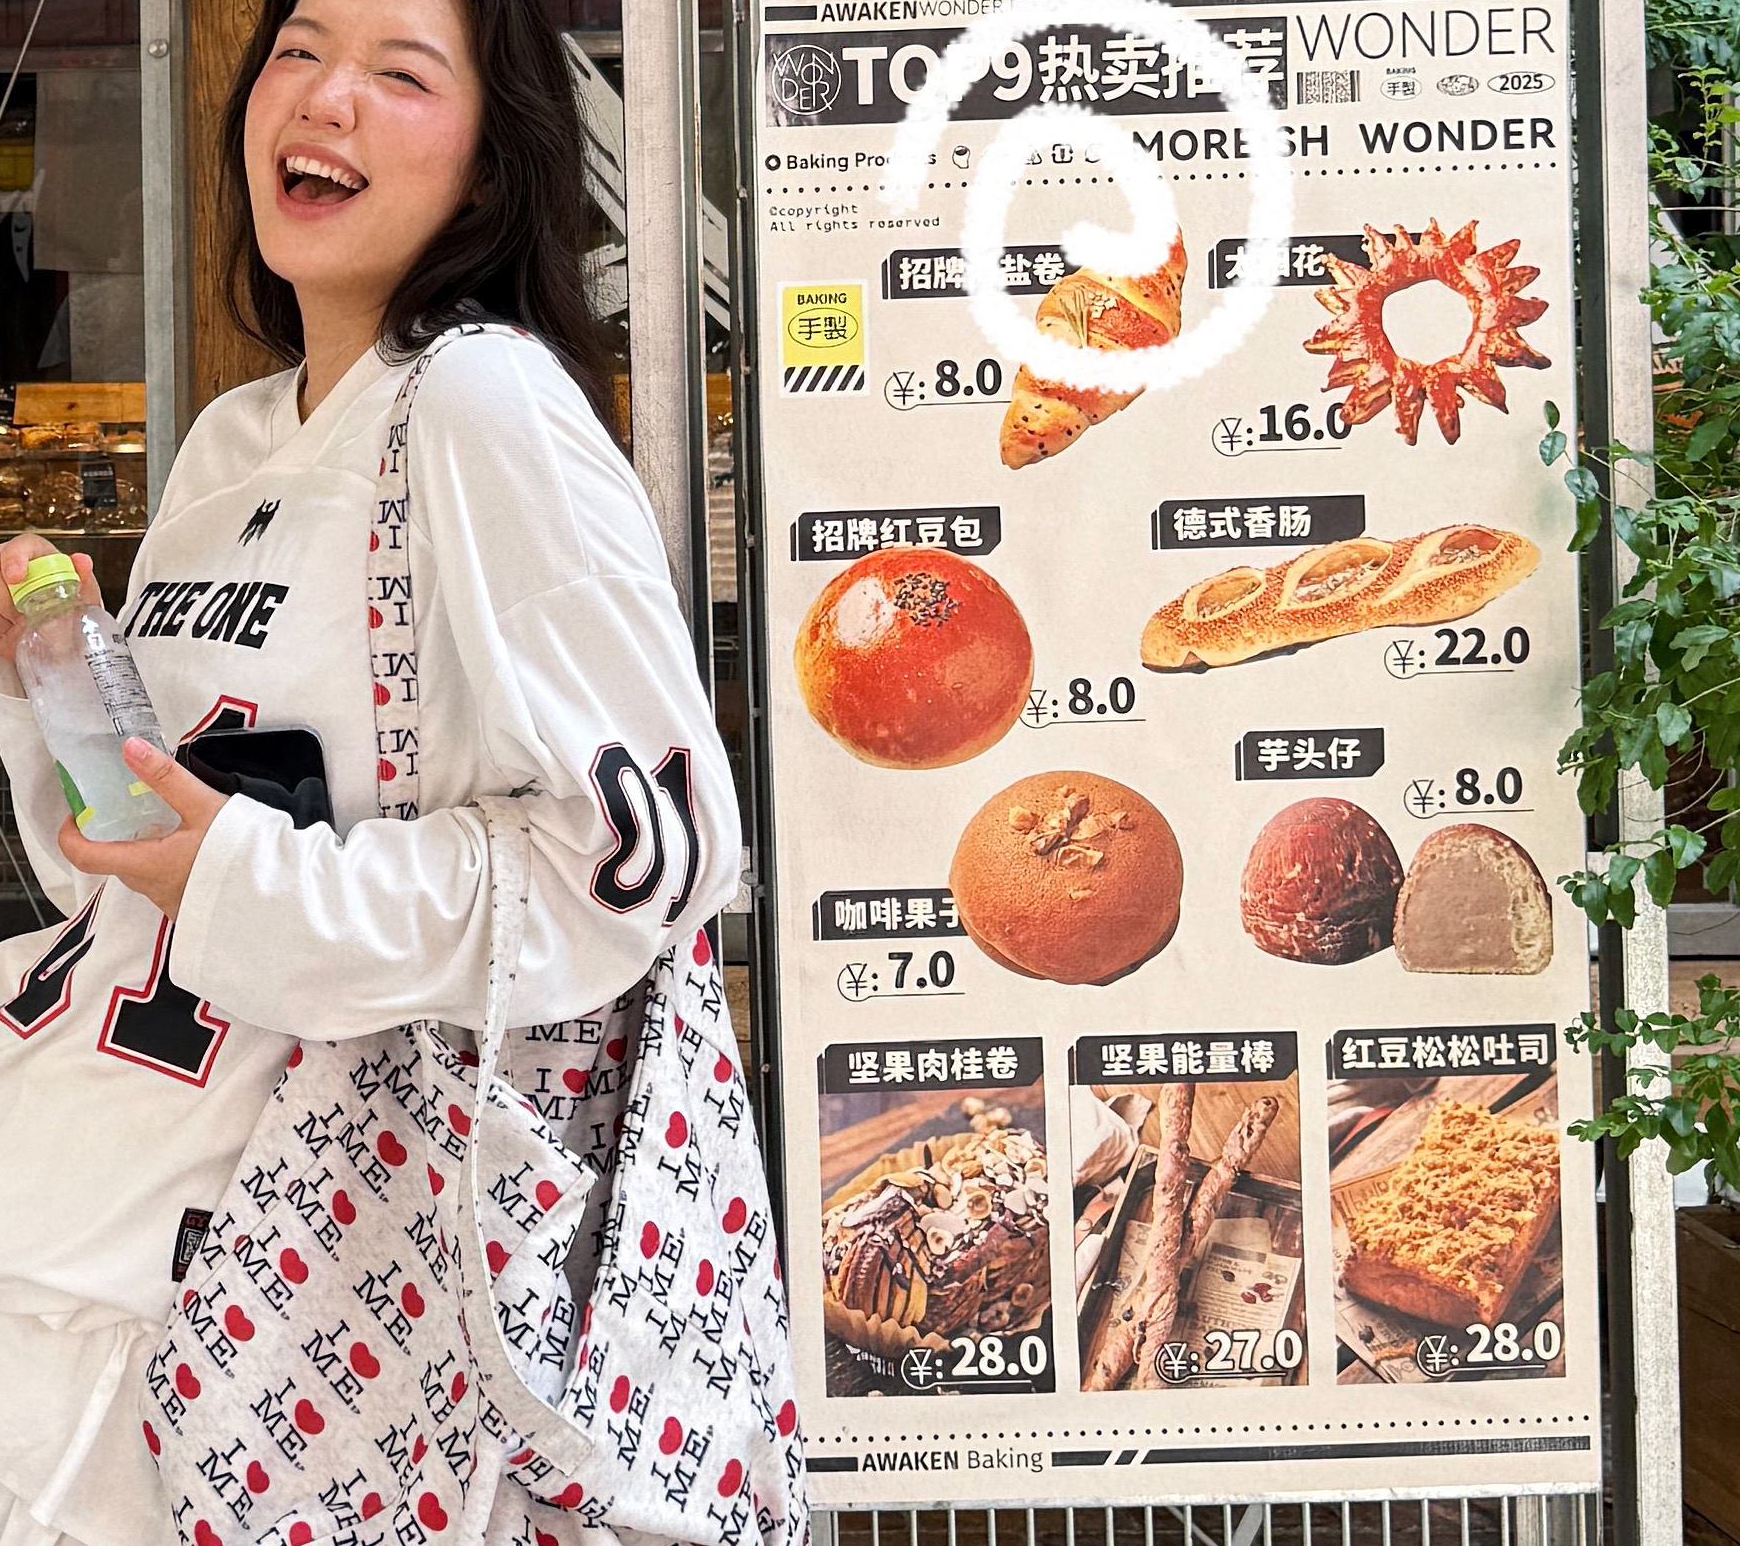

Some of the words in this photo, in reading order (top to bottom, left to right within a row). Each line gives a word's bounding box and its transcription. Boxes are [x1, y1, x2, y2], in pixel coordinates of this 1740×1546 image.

[1297, 7, 1556, 62] WONDER
[1499, 73, 1544, 90] 2025
[1134, 125, 1329, 164] MORESH
[1359, 118, 1556, 155] WONDER
[786, 154, 849, 172] Baking
[770, 220, 795, 233] All
[806, 218, 859, 233] rights
[899, 252, 1065, 291] 招牌盐卷
[797, 293, 847, 305] BAKING
[812, 515, 984, 553] 招牌红豆包
[1173, 505, 1312, 541] 德式香肠
[125, 581, 214, 638] THE
[192, 581, 290, 650] ONE
[1257, 736, 1361, 773] 芋头仔
[526, 1020, 602, 1044] ME
[848, 1046, 1019, 1085] 坚果肉桂卷
[1101, 1039, 1275, 1077] 坚果能量棒
[1342, 1033, 1548, 1071] 红豆松松吐司
[862, 1450, 959, 1472] AWAKEN
[968, 1447, 1043, 1473] Baking
